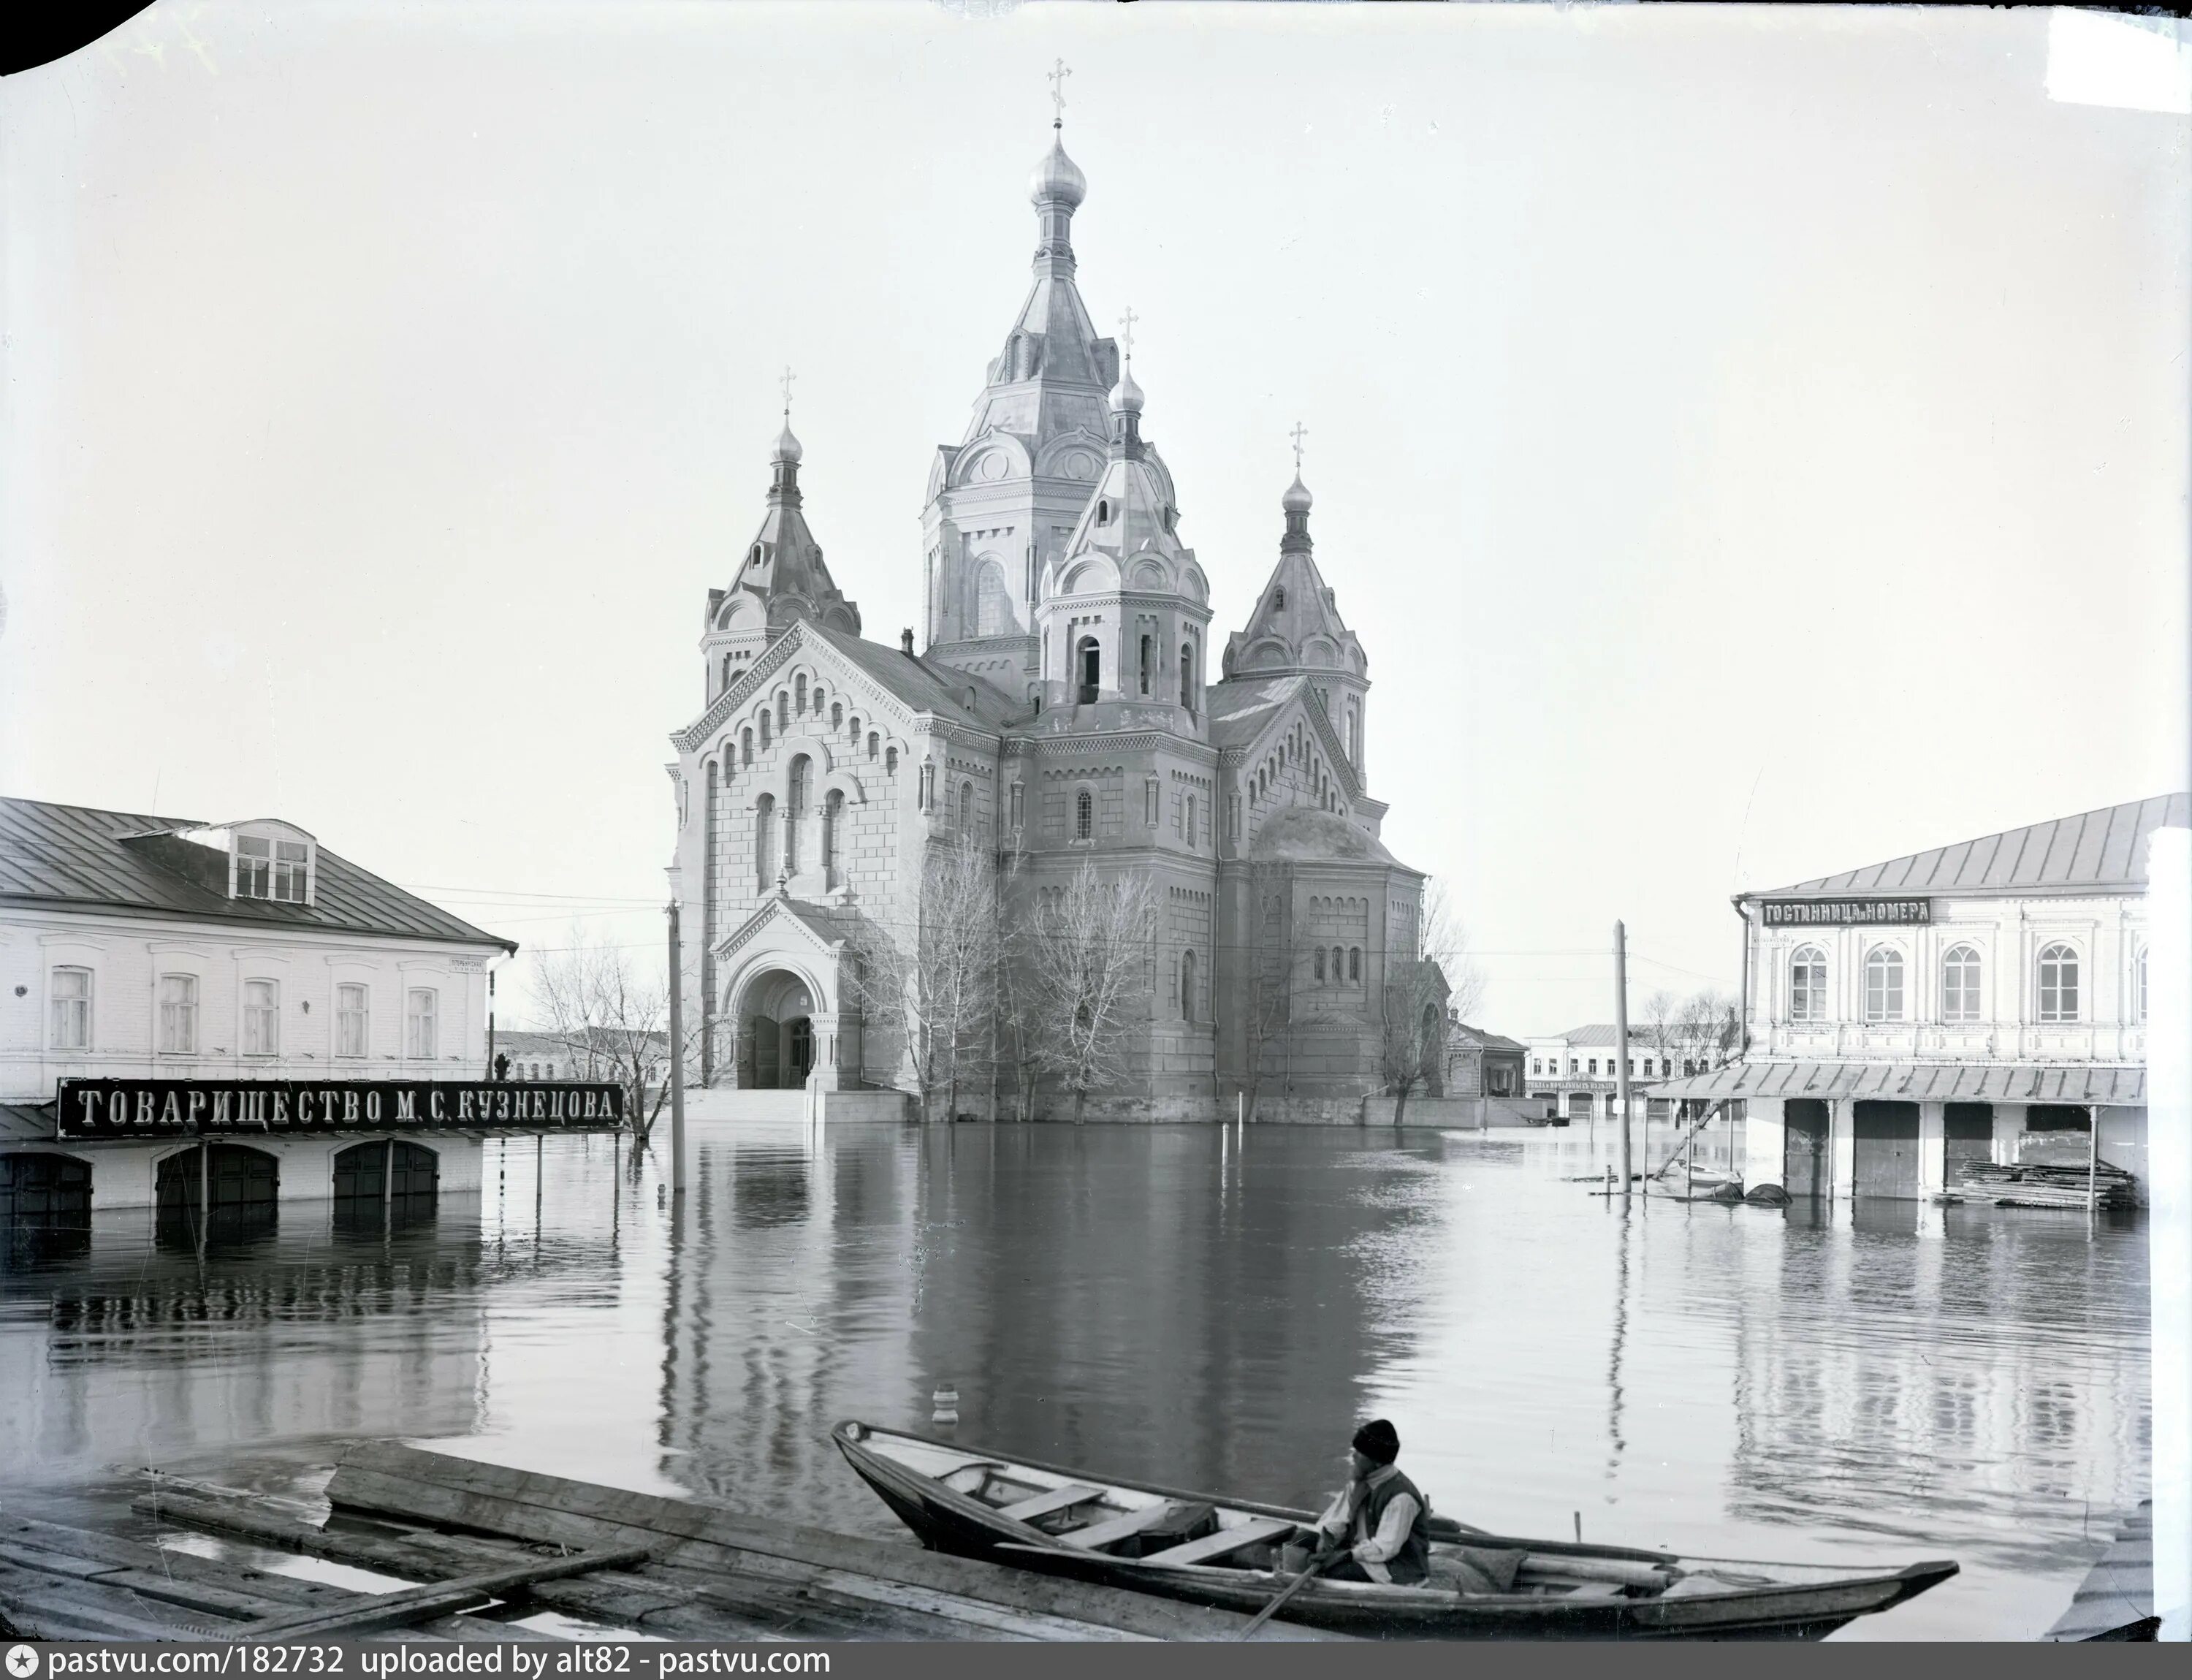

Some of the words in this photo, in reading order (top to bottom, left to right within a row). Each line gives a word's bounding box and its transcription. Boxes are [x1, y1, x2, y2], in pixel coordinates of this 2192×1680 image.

[1765, 903, 1860, 922] ГОСТИННИЦА
[1865, 902, 1929, 921] НОМЕРА
[77, 1090, 381, 1132] ТОВАРИЩЕСТВО
[397, 1090, 424, 1123] М.
[430, 1090, 452, 1122] С.
